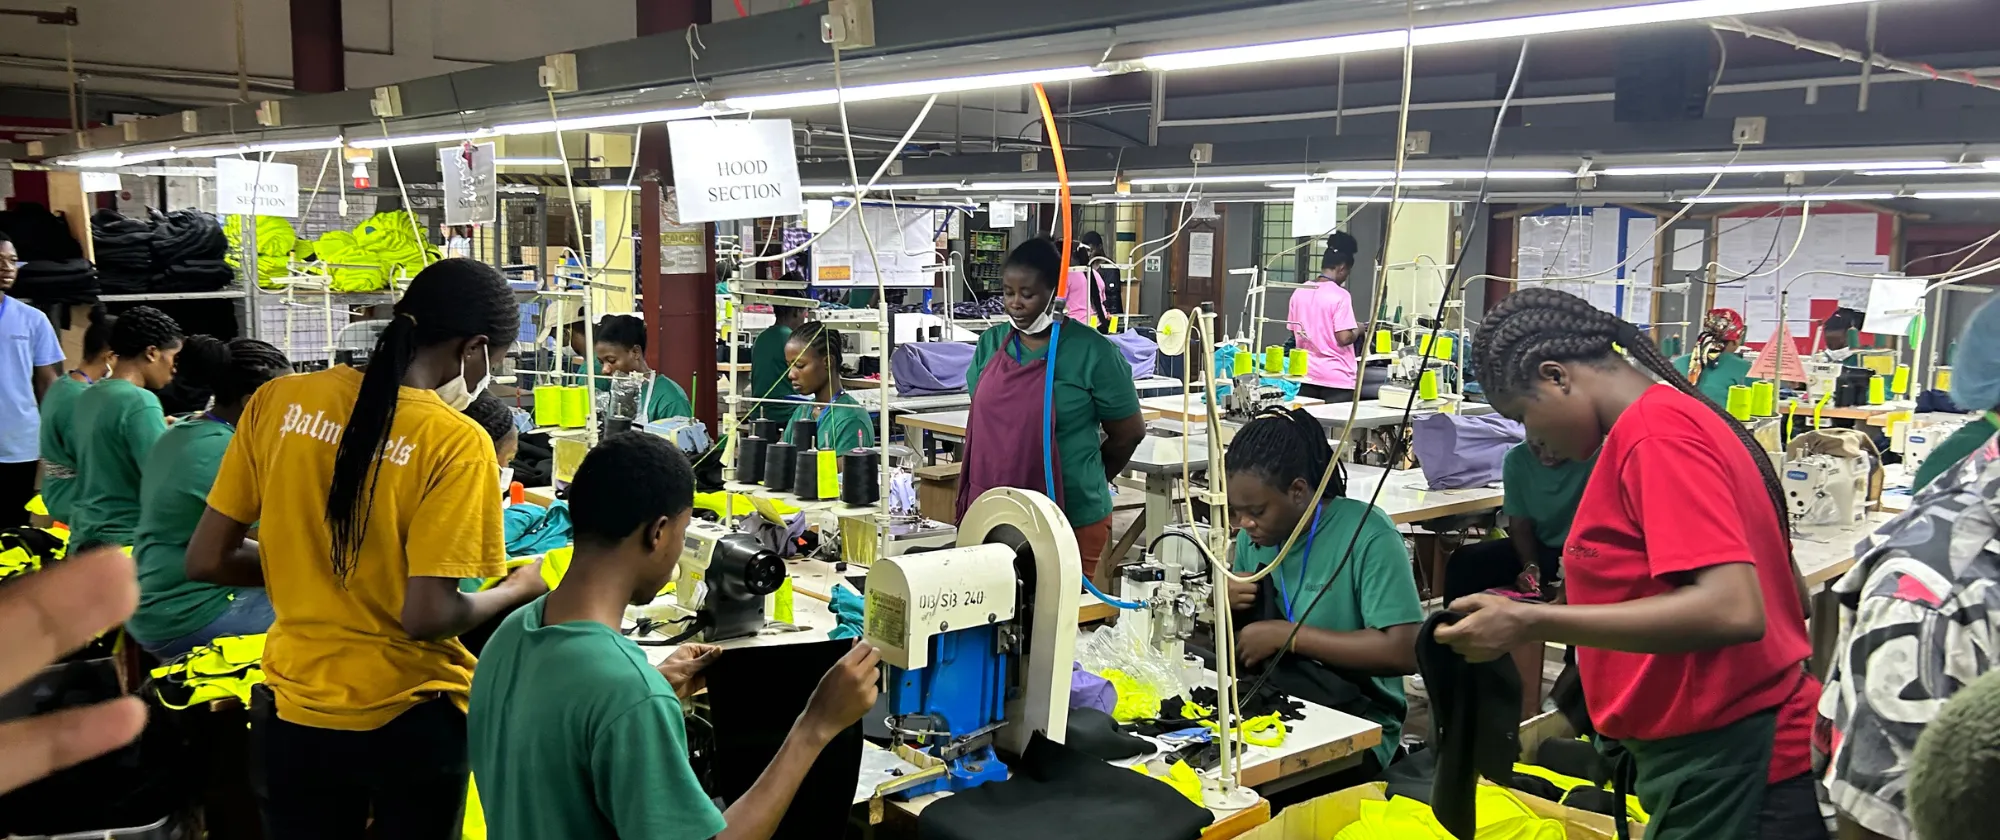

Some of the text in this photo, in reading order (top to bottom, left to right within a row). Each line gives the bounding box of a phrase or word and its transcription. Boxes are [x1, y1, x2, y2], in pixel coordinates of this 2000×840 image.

[718, 160, 768, 176] HOOD
[244, 182, 279, 193] HOOD
[708, 183, 782, 202] SECTION
[236, 195, 286, 207] SECTION
[280, 403, 417, 466] Palm els
[964, 590, 984, 606] 240
